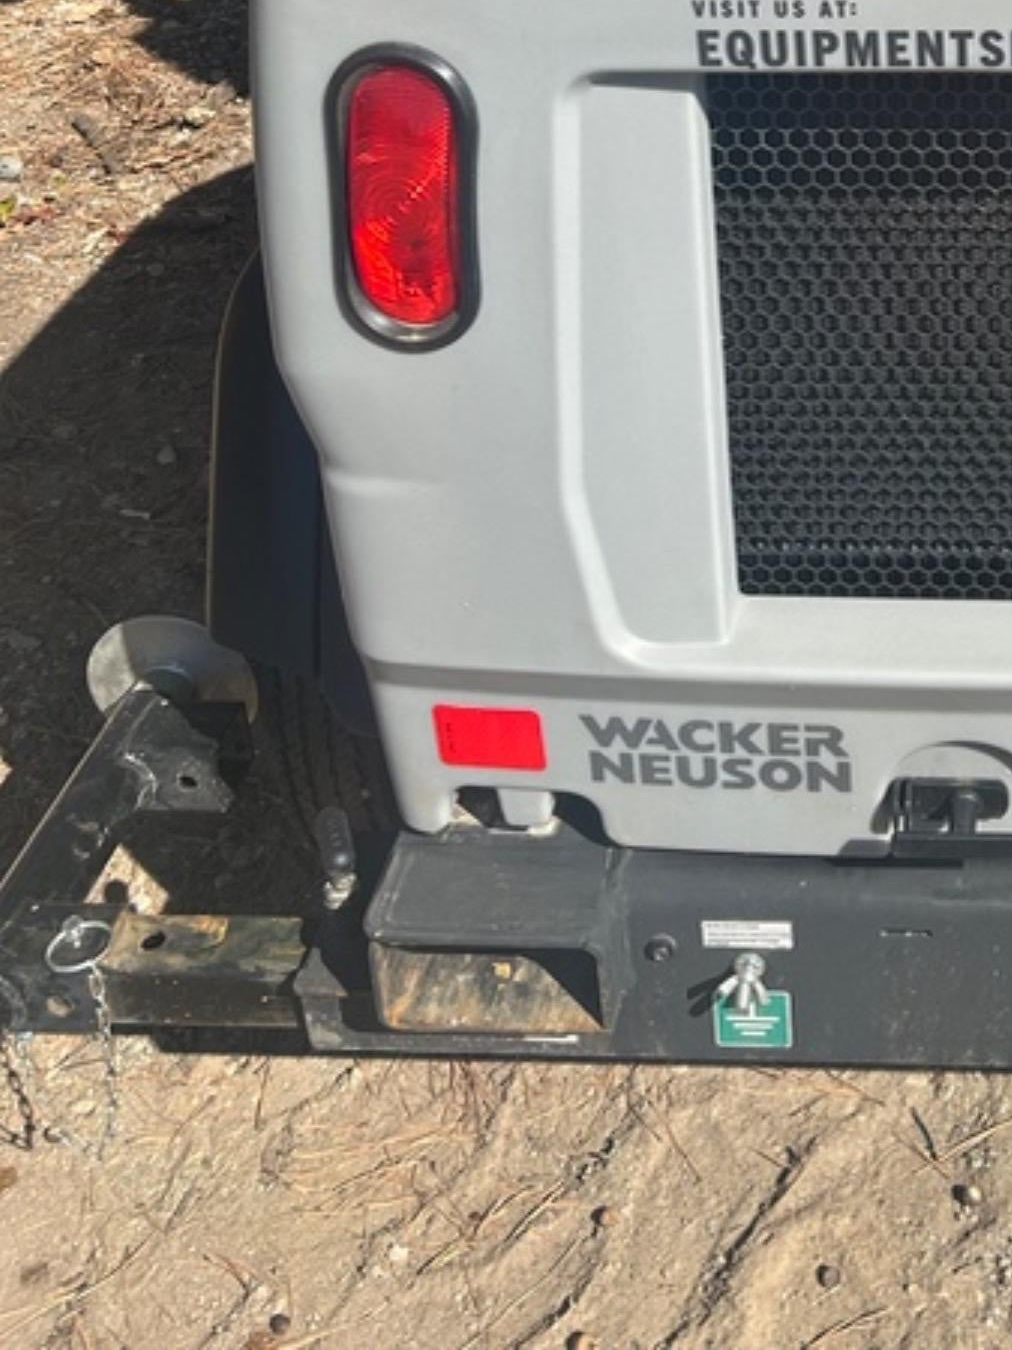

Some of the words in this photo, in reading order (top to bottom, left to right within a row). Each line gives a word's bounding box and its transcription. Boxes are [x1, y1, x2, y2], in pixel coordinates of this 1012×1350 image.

[691, 0, 760, 19] VISIT
[774, 0, 807, 19] US
[818, 0, 859, 19] AT:
[578, 714, 850, 757] WACKER
[588, 751, 852, 793] NEUSON
